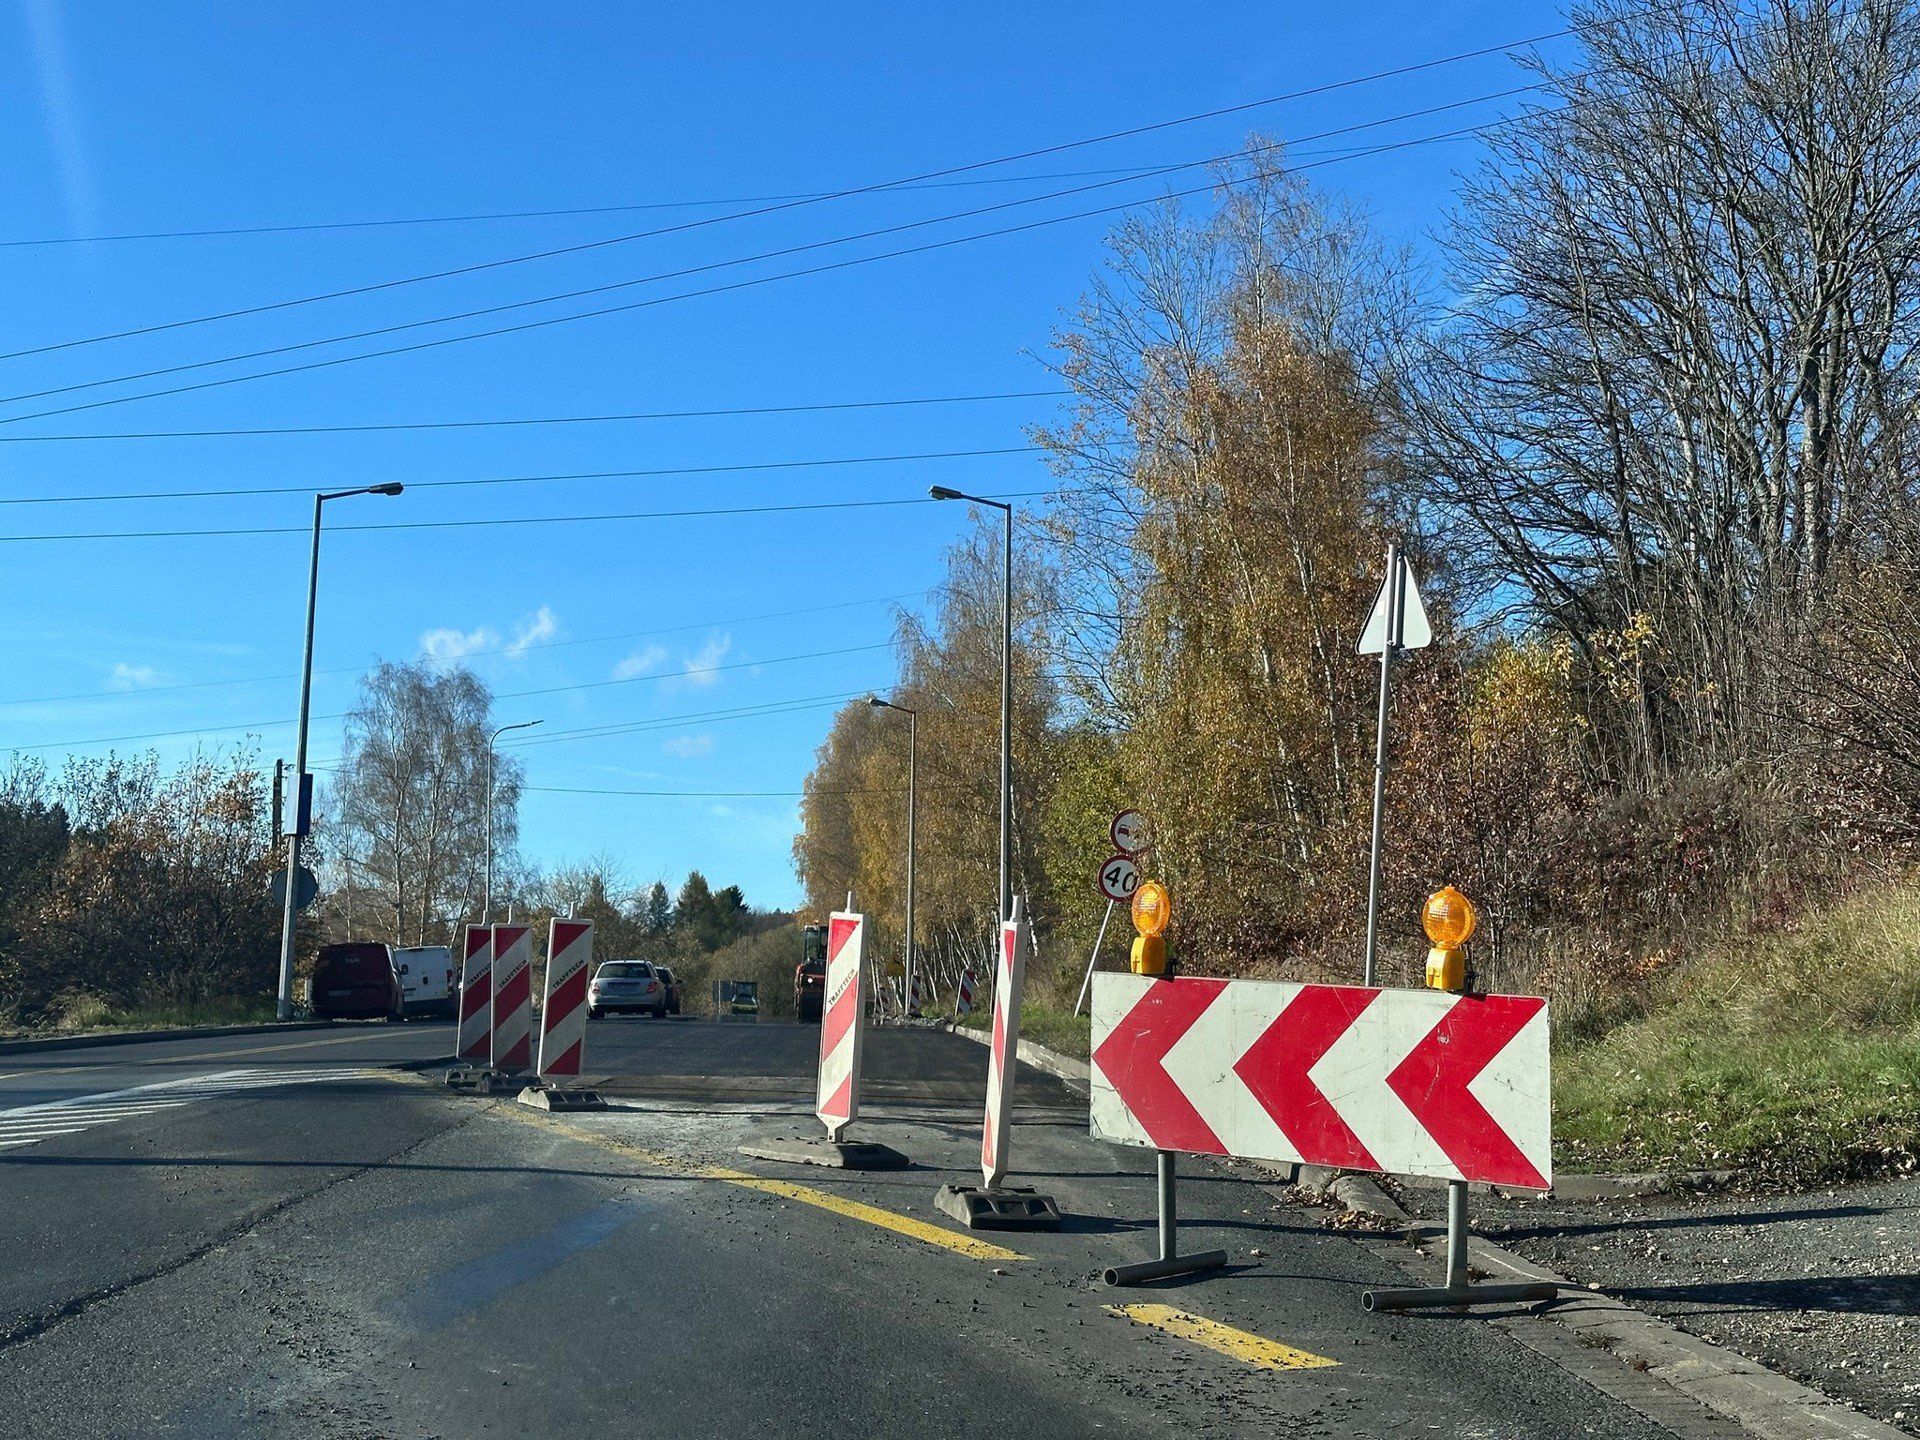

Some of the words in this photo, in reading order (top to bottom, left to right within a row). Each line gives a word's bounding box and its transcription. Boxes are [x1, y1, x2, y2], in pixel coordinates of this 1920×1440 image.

[1105, 867, 1139, 892] 40
[552, 958, 585, 989] TRAFFTECH
[828, 968, 855, 1006] TRAFFTECH
